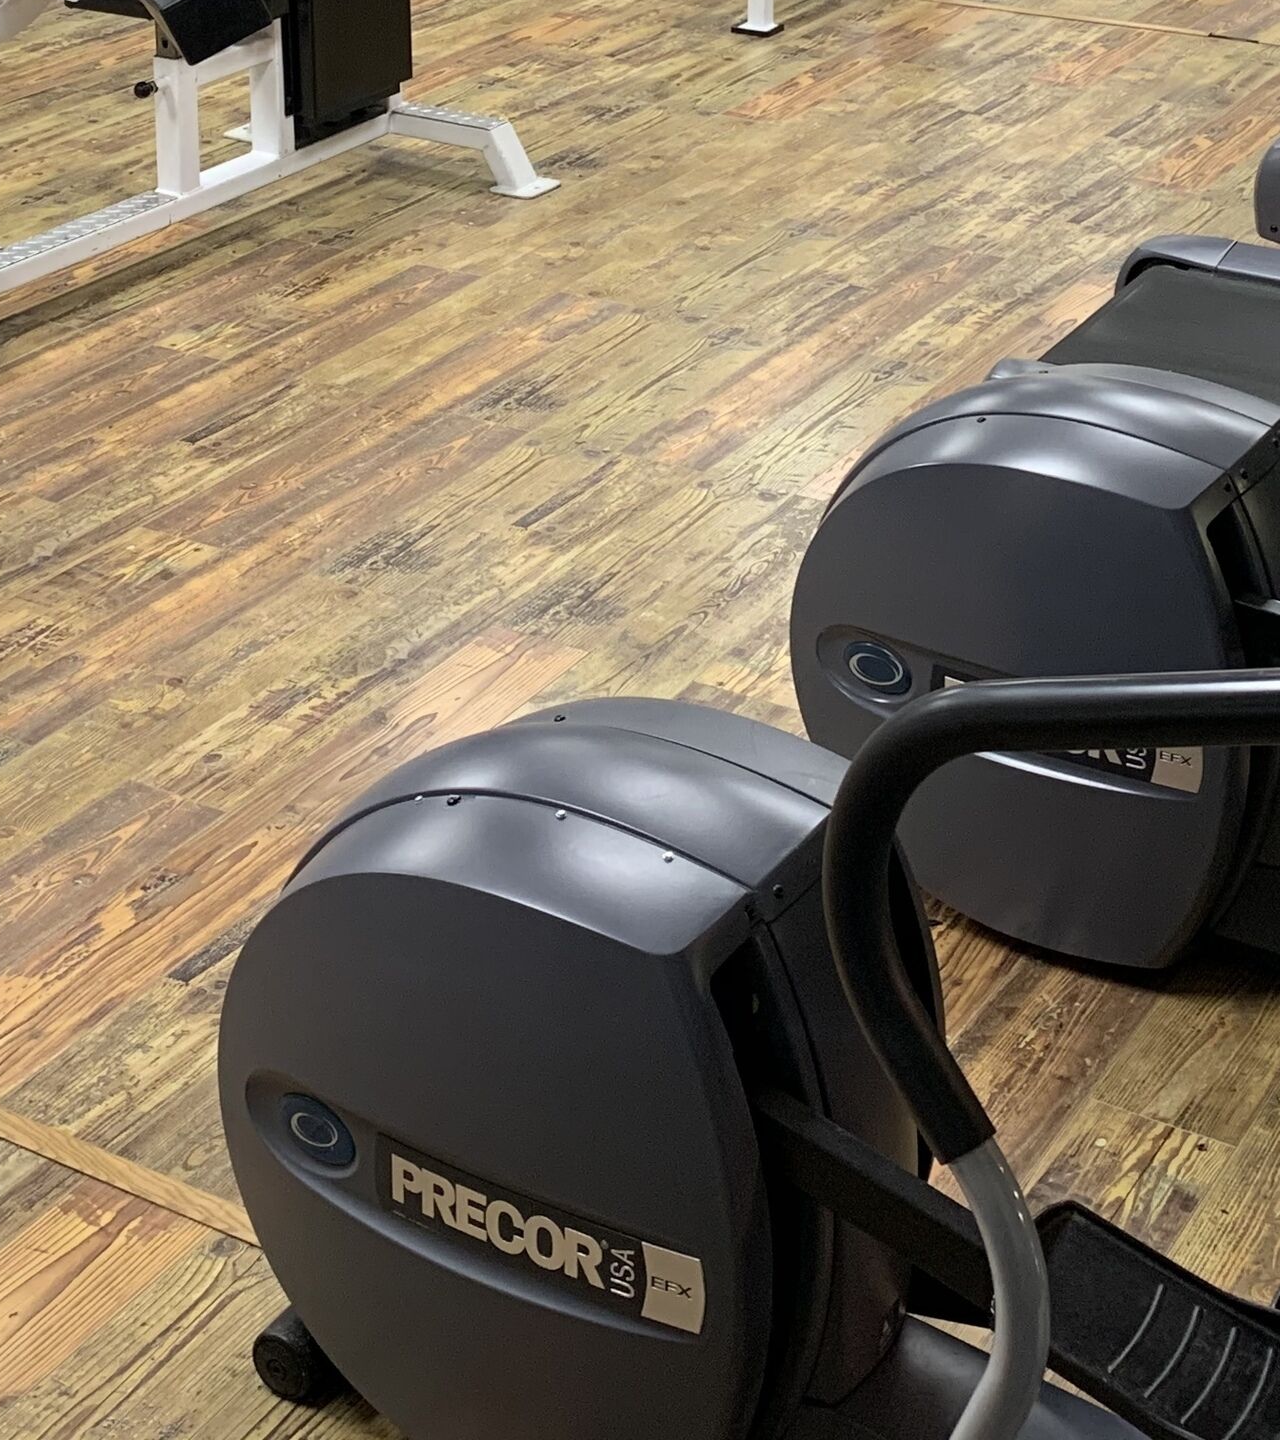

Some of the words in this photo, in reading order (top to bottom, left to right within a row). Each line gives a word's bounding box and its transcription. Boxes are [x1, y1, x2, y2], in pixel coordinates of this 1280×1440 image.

[1125, 747, 1148, 770] US
[1159, 751, 1193, 767] EFX
[391, 1153, 606, 1290] PRECOR
[610, 1248, 635, 1299] USA
[650, 1275, 693, 1300] EFX
